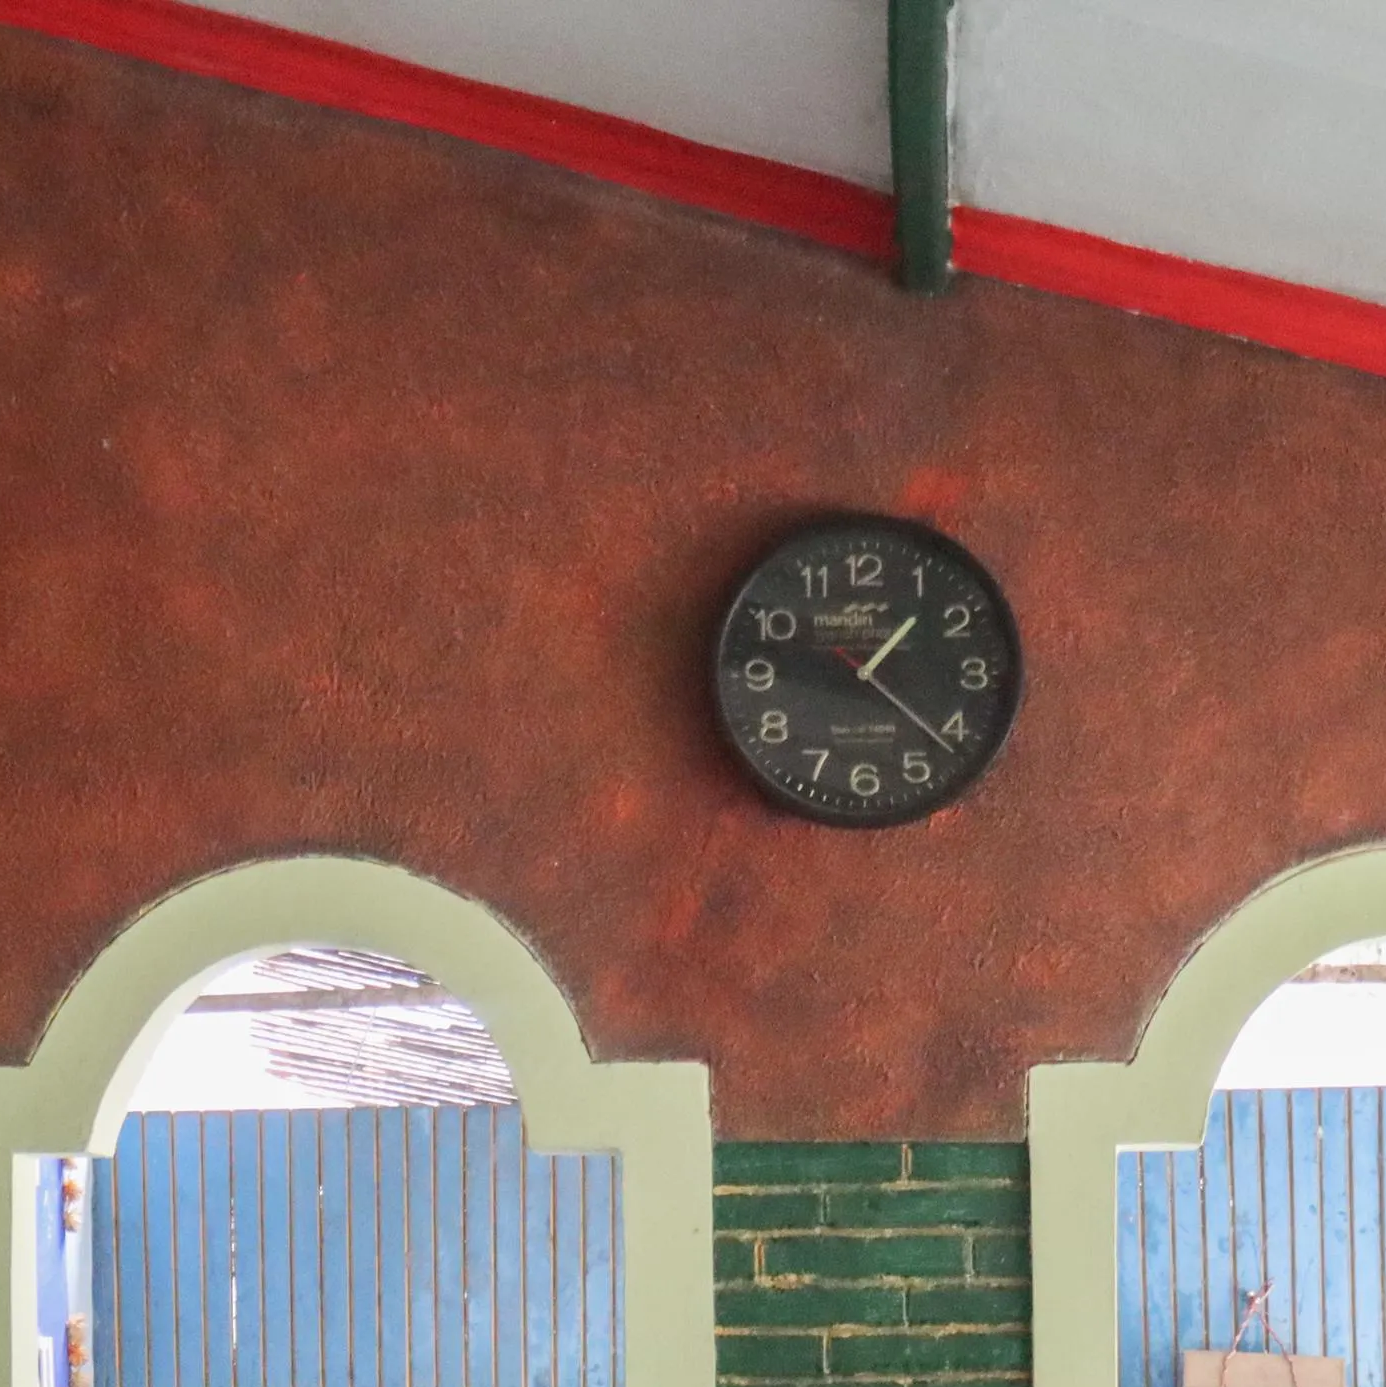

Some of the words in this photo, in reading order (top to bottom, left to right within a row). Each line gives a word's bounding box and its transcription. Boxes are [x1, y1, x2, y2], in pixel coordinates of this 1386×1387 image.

[801, 566, 828, 598] 11
[846, 554, 883, 587] 12
[913, 566, 923, 597] 1
[754, 609, 796, 641] 10
[944, 605, 970, 637] 2
[745, 659, 774, 691] 9
[960, 657, 988, 690] 3
[761, 710, 788, 743] 8
[940, 710, 969, 742] 4
[802, 750, 829, 781] 7
[850, 764, 880, 796] 6
[903, 752, 931, 783] 5
